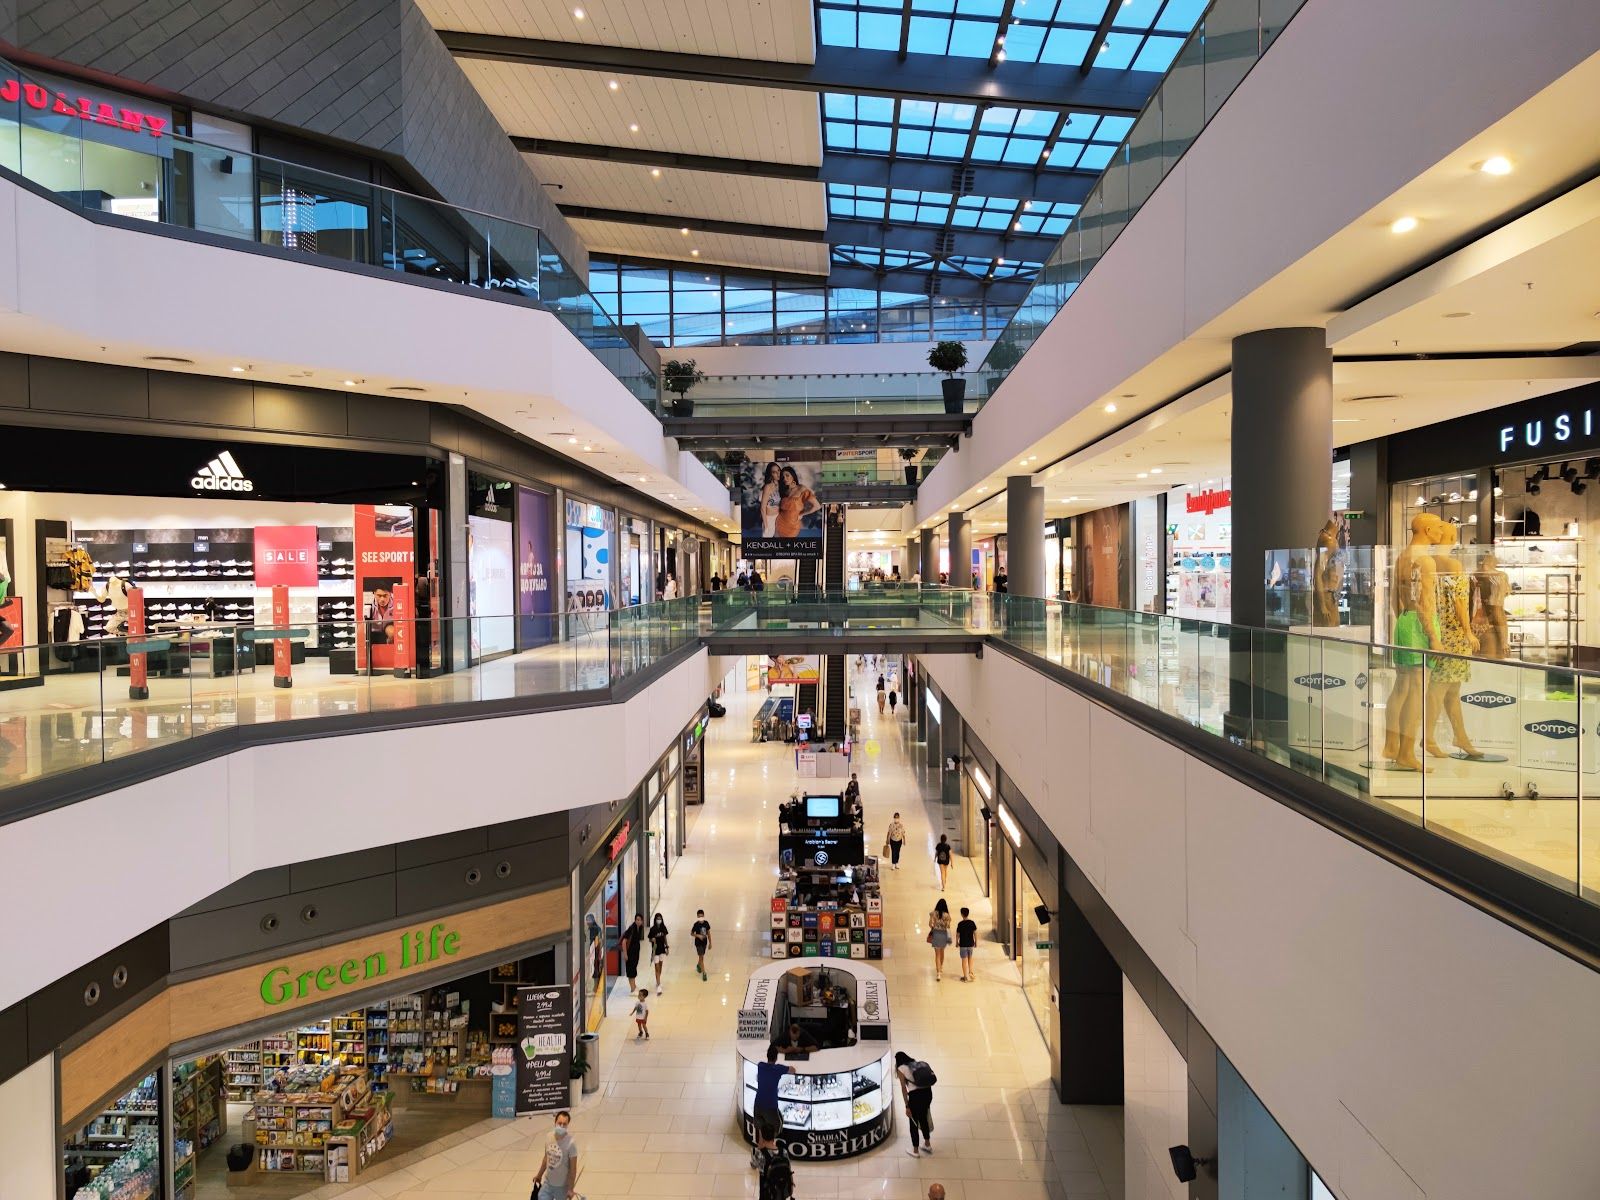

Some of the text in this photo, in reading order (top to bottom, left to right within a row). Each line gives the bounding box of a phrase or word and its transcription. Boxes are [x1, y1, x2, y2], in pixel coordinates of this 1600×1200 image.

[0, 80, 168, 137] JULIANY
[1500, 409, 1591, 452] FUSI
[191, 475, 254, 492] adidas
[746, 541, 784, 549] KENDALL
[793, 541, 817, 549] KYLIE
[265, 551, 307, 562] SALE
[361, 552, 378, 563] SEE
[379, 552, 408, 563] SPORT
[396, 602, 404, 651] SALE
[1299, 676, 1341, 686] pomea
[1466, 695, 1512, 704] pompea
[1531, 723, 1578, 735] pompe
[260, 923, 461, 1006] Green life
[751, 979, 770, 1010] ЧАСОВН
[538, 1034, 562, 1048] HEALTH
